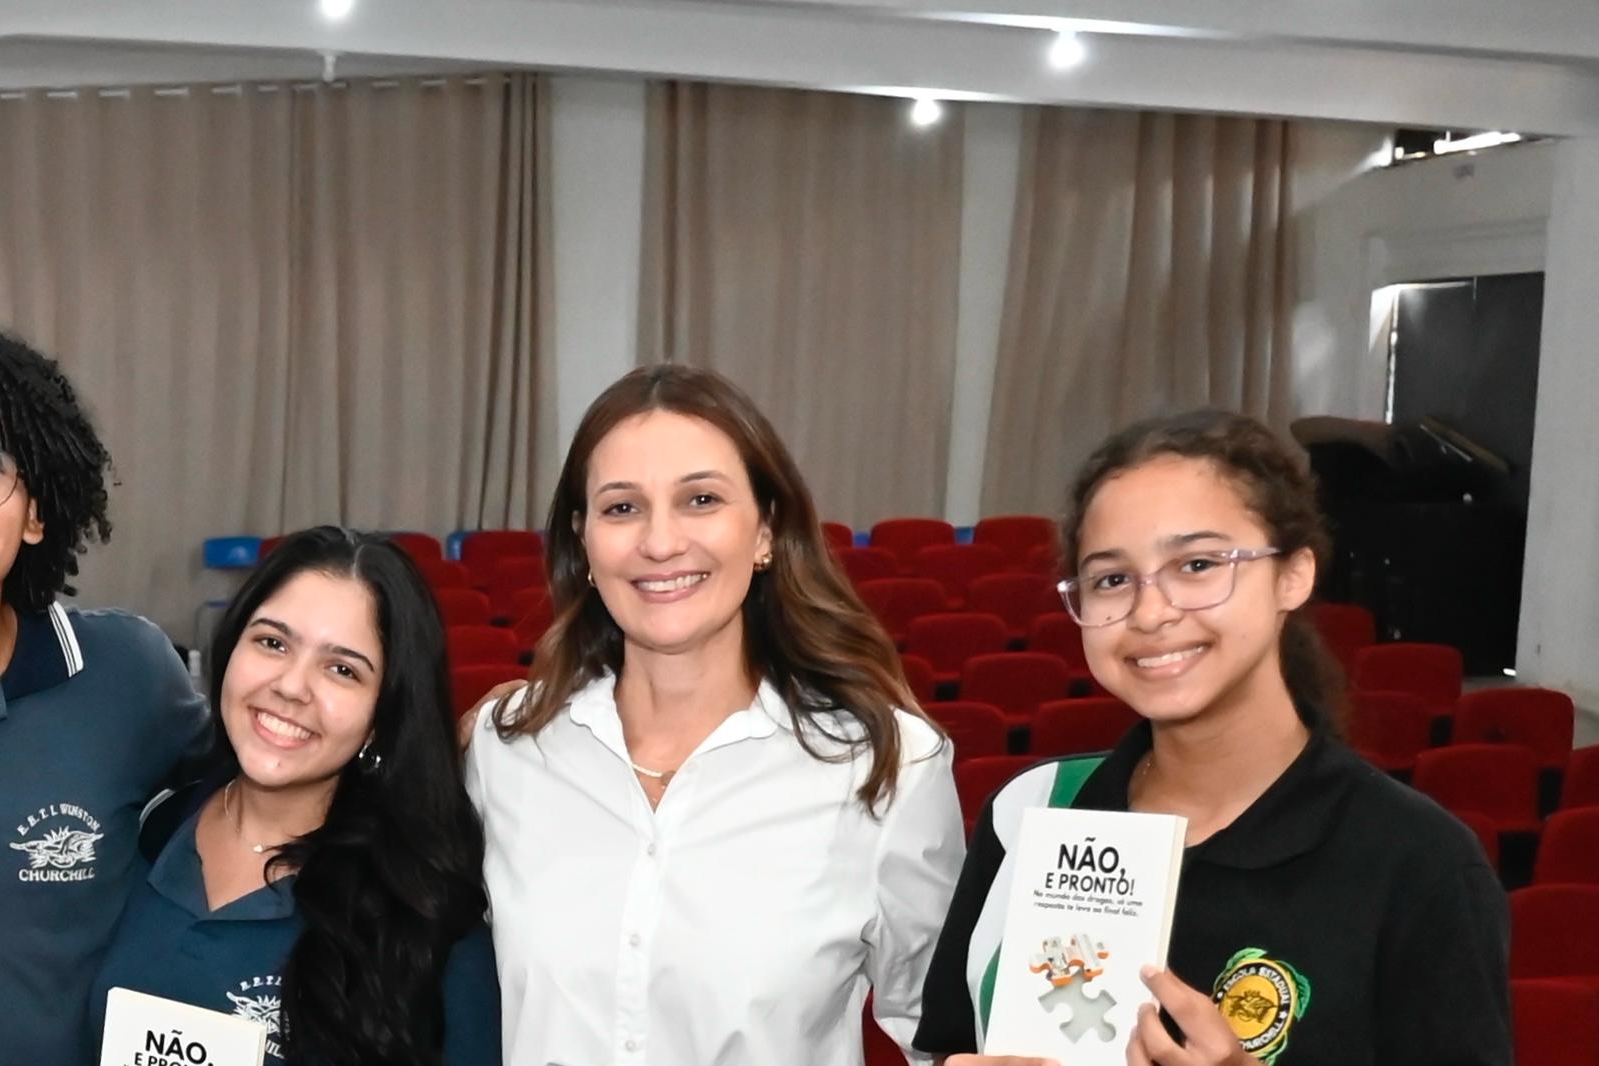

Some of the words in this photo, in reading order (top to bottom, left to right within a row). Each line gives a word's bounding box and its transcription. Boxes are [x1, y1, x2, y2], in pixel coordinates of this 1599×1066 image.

[60, 803, 101, 831] WINSTON
[1057, 837, 1126, 878] NÃO,
[19, 867, 95, 881] CHURCHILL
[1045, 872, 1054, 889] E
[1058, 873, 1135, 896] PRONTO!
[1223, 967, 1256, 991] ESCOLA
[1258, 966, 1290, 1004] ESTADUAL
[134, 1051, 143, 1066] E
